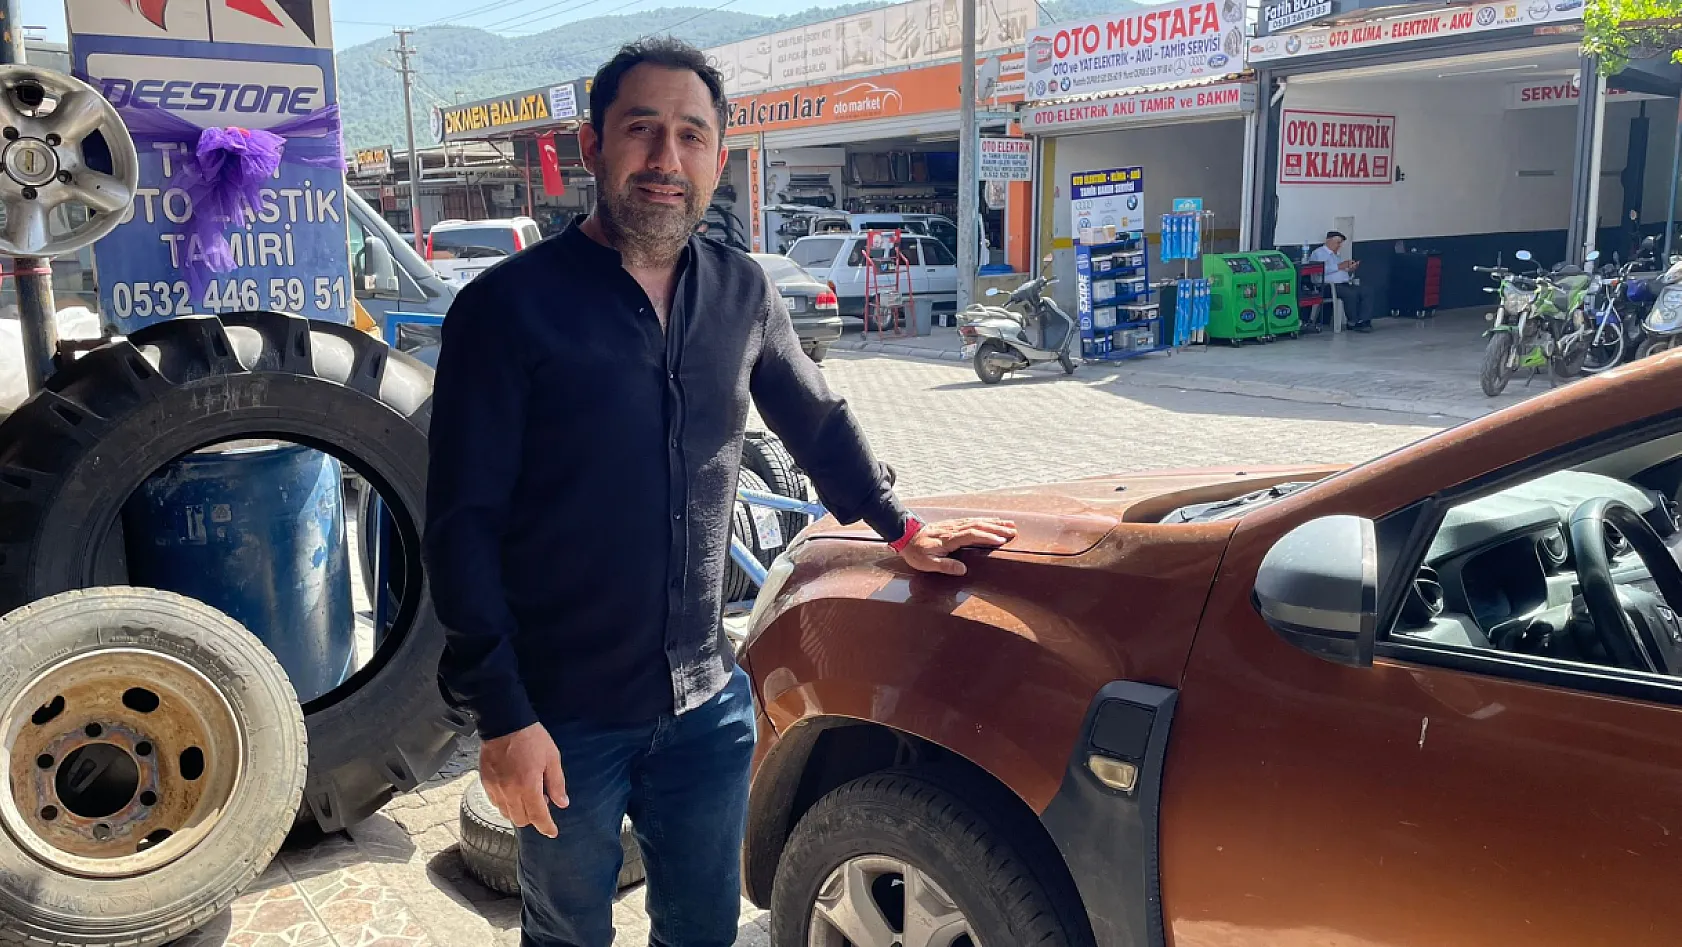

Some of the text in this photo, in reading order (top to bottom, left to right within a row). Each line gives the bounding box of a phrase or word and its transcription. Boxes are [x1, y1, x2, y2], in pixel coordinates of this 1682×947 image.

[1264, 0, 1291, 21] Fatih
[1329, 29, 1349, 47] OTO
[1392, 14, 1440, 39] ELEKTRİK
[1450, 8, 1473, 30] AKÜ
[1054, 2, 1219, 58] OTO MUSTAFA
[1053, 63, 1068, 76] OTO
[1069, 64, 1078, 74] ve
[1078, 59, 1094, 72] YAT
[1094, 53, 1129, 70] ELEKTRİK
[1135, 45, 1153, 64] AKÜ
[1160, 39, 1186, 59] TAMİR
[1187, 33, 1221, 56] SERVİSİ
[99, 77, 318, 115] DEESTONE
[491, 93, 548, 126] BALATA
[727, 93, 827, 127] Yalçınlar
[833, 95, 881, 114] oto market
[1035, 111, 1054, 124] OTO
[1113, 100, 1135, 115] AKÜ
[1180, 97, 1192, 107] ve
[1197, 89, 1239, 106] BAKIM
[982, 141, 996, 153] OTO
[1287, 118, 1390, 149] OTO ELEKTRİK
[113, 276, 346, 318] 0532 446 59 51
